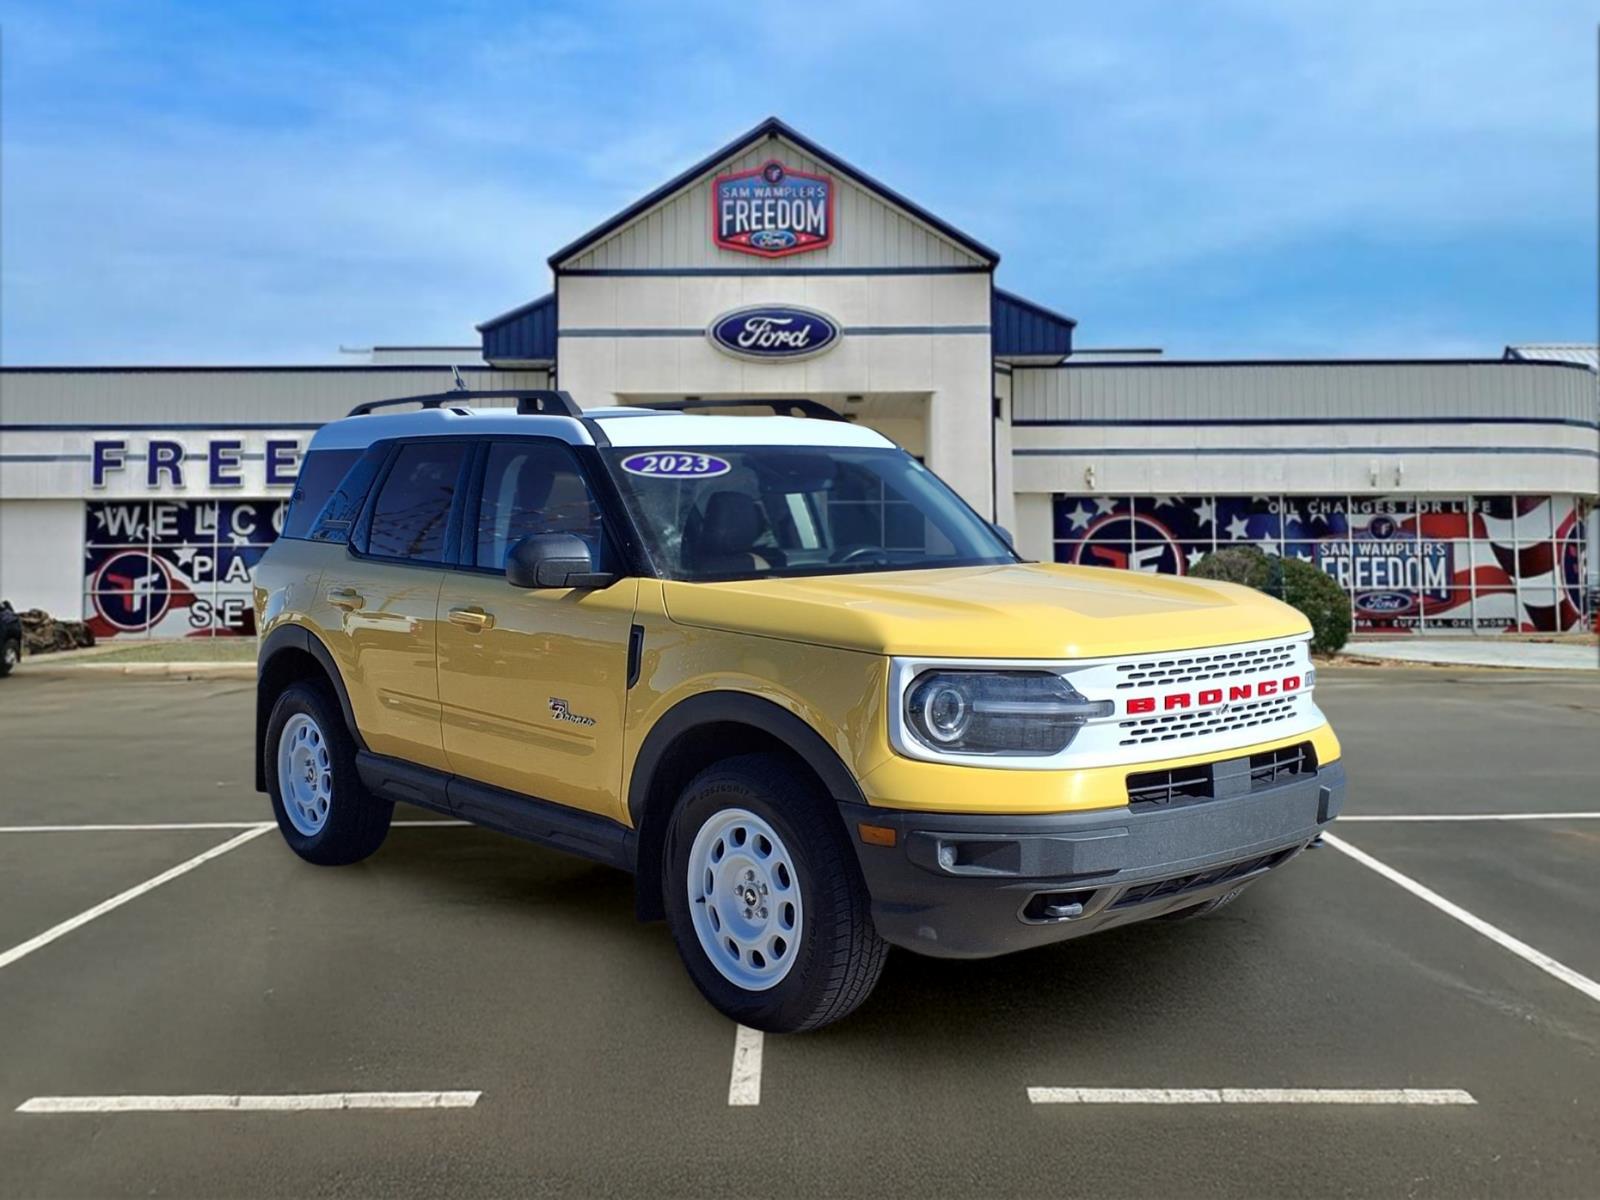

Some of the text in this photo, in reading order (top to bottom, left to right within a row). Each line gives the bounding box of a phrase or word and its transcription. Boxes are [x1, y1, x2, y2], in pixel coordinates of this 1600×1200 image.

[722, 187, 749, 198] SAM
[722, 199, 825, 236] FREEDOM
[758, 233, 787, 247] Ford
[738, 316, 811, 347] Ford
[641, 456, 710, 472] 2023
[1268, 501, 1491, 514] OIL CHANGES FOR LIFE
[1366, 596, 1400, 609] Ford
[1126, 676, 1300, 714] BRONCO
